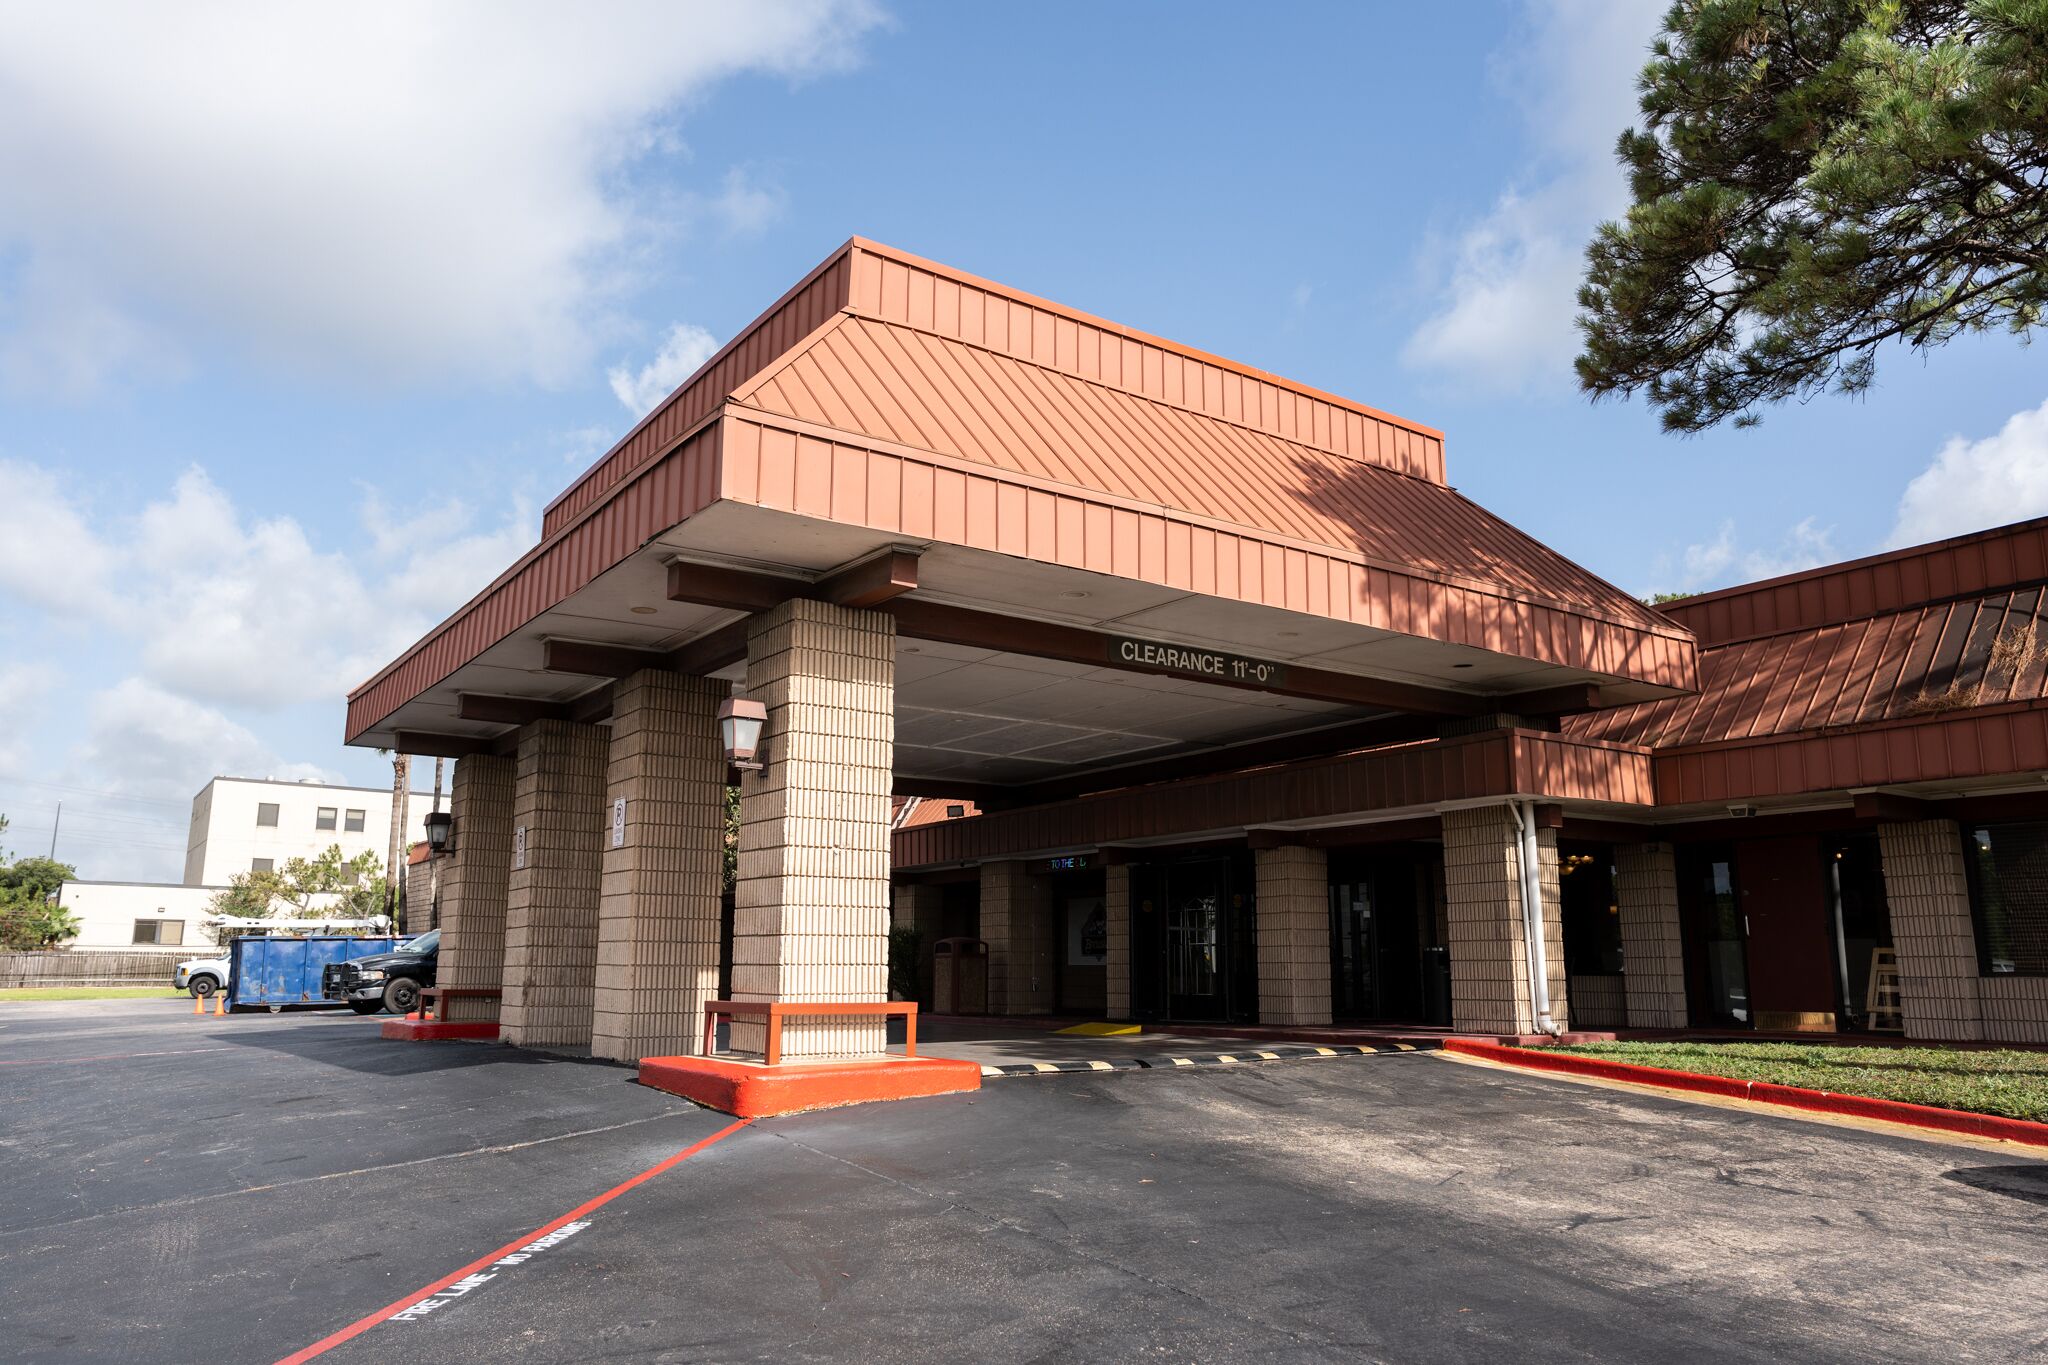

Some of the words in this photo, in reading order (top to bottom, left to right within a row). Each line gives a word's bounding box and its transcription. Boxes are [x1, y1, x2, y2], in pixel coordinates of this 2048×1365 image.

[1121, 641, 1225, 675] CLEARANCE
[388, 1298, 451, 1321] FIRE
[434, 1273, 498, 1297] LANE
[494, 1253, 532, 1265] NO
[519, 1221, 593, 1252] PARKING
